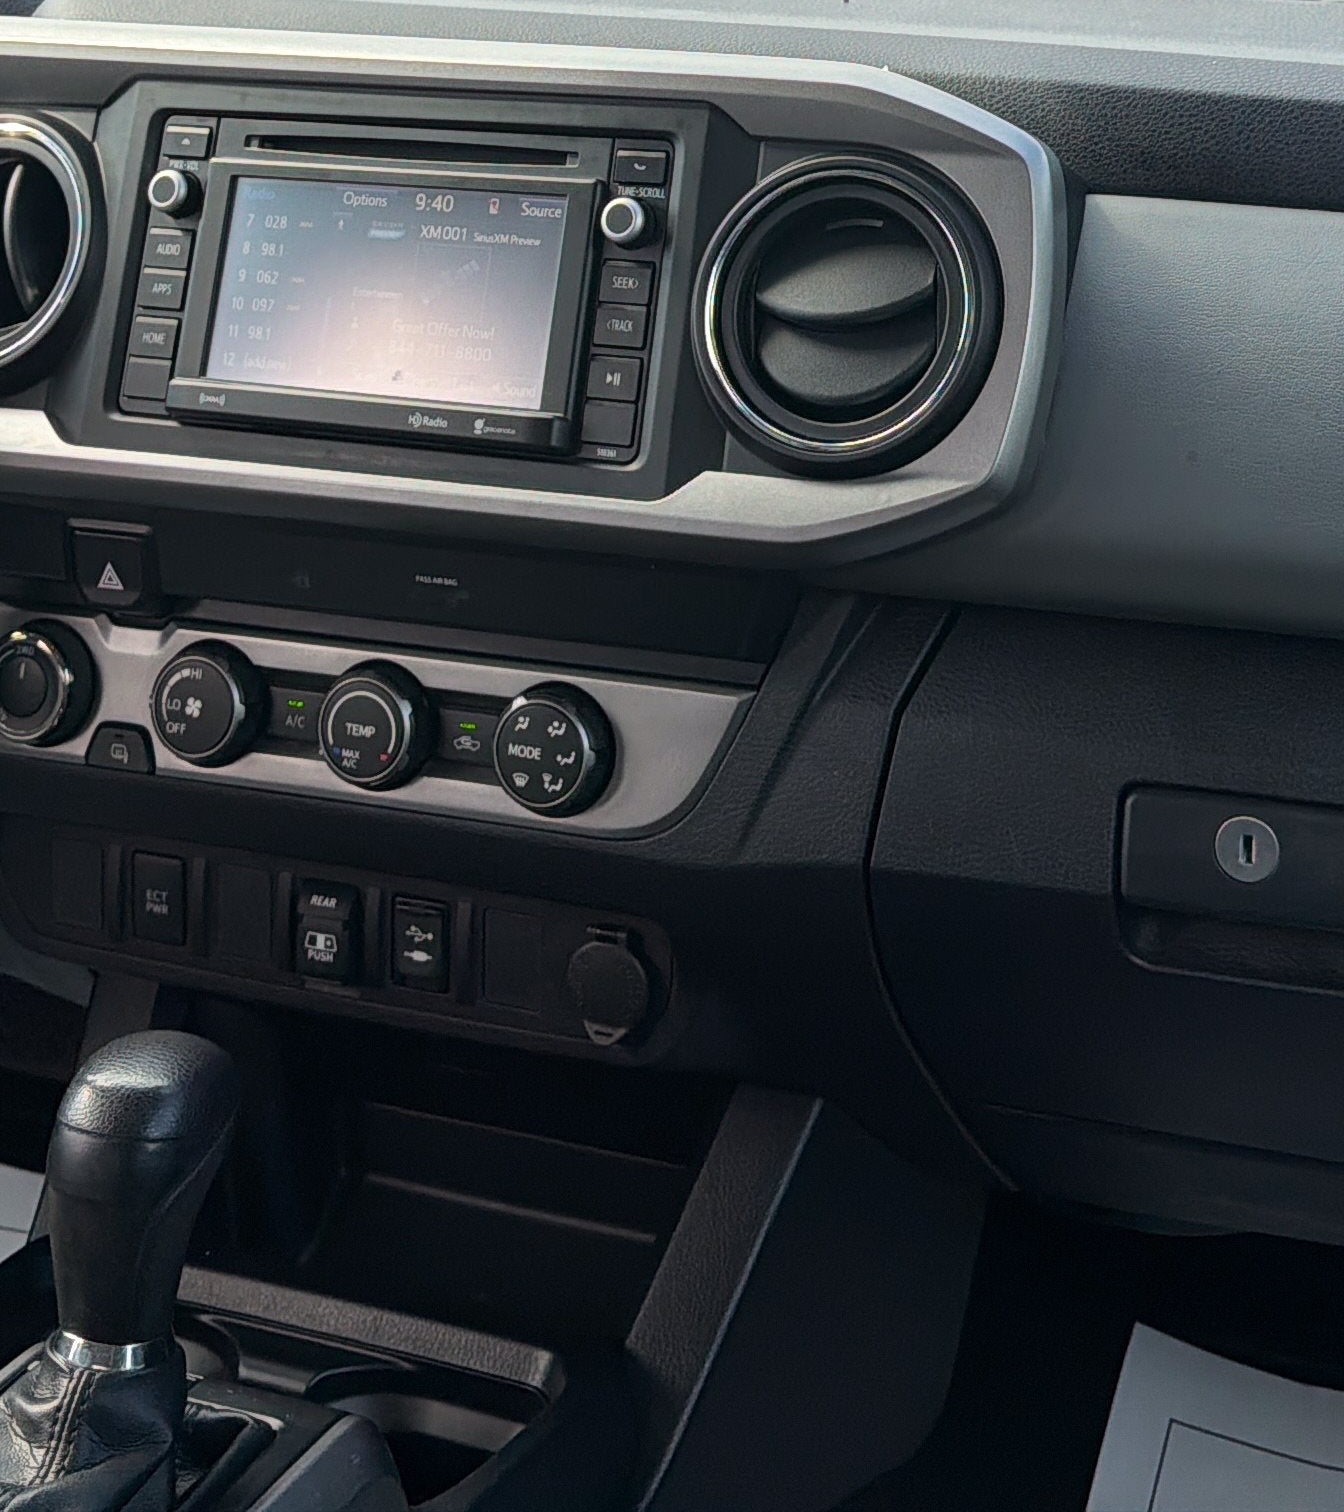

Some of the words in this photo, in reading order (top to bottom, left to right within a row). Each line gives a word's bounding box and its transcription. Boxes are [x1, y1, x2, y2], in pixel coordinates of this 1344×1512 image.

[342, 191, 388, 208] Options
[415, 192, 455, 213] 9:40
[520, 201, 563, 219] Source
[246, 213, 256, 228] 7
[264, 215, 288, 230] 028
[242, 240, 251, 255] 8
[261, 242, 285, 257] 98.1
[510, 234, 542, 248] Preview
[155, 242, 182, 257] AUDIO
[237, 268, 247, 283] 9
[255, 270, 280, 286] 062
[151, 282, 173, 296] APPS
[231, 296, 245, 311] 10
[251, 298, 276, 313] 097
[227, 323, 239, 339] 11
[247, 324, 272, 342] 98.1
[426, 320, 461, 338] Offer
[141, 331, 167, 346] HOME
[222, 351, 236, 367] 12
[503, 381, 537, 398] Sound
[422, 414, 449, 430] Radio
[190, 667, 203, 681] HI
[166, 698, 182, 710] LO
[165, 721, 187, 735] OFF
[285, 713, 306, 729] A/C
[344, 721, 376, 739] TEMP
[341, 747, 361, 760] MAX
[507, 741, 543, 761] MODE
[342, 758, 358, 769] A/C
[145, 888, 169, 903] ECT
[309, 894, 338, 909] REAR
[145, 901, 169, 916] PWR
[307, 948, 335, 964] PUSH
